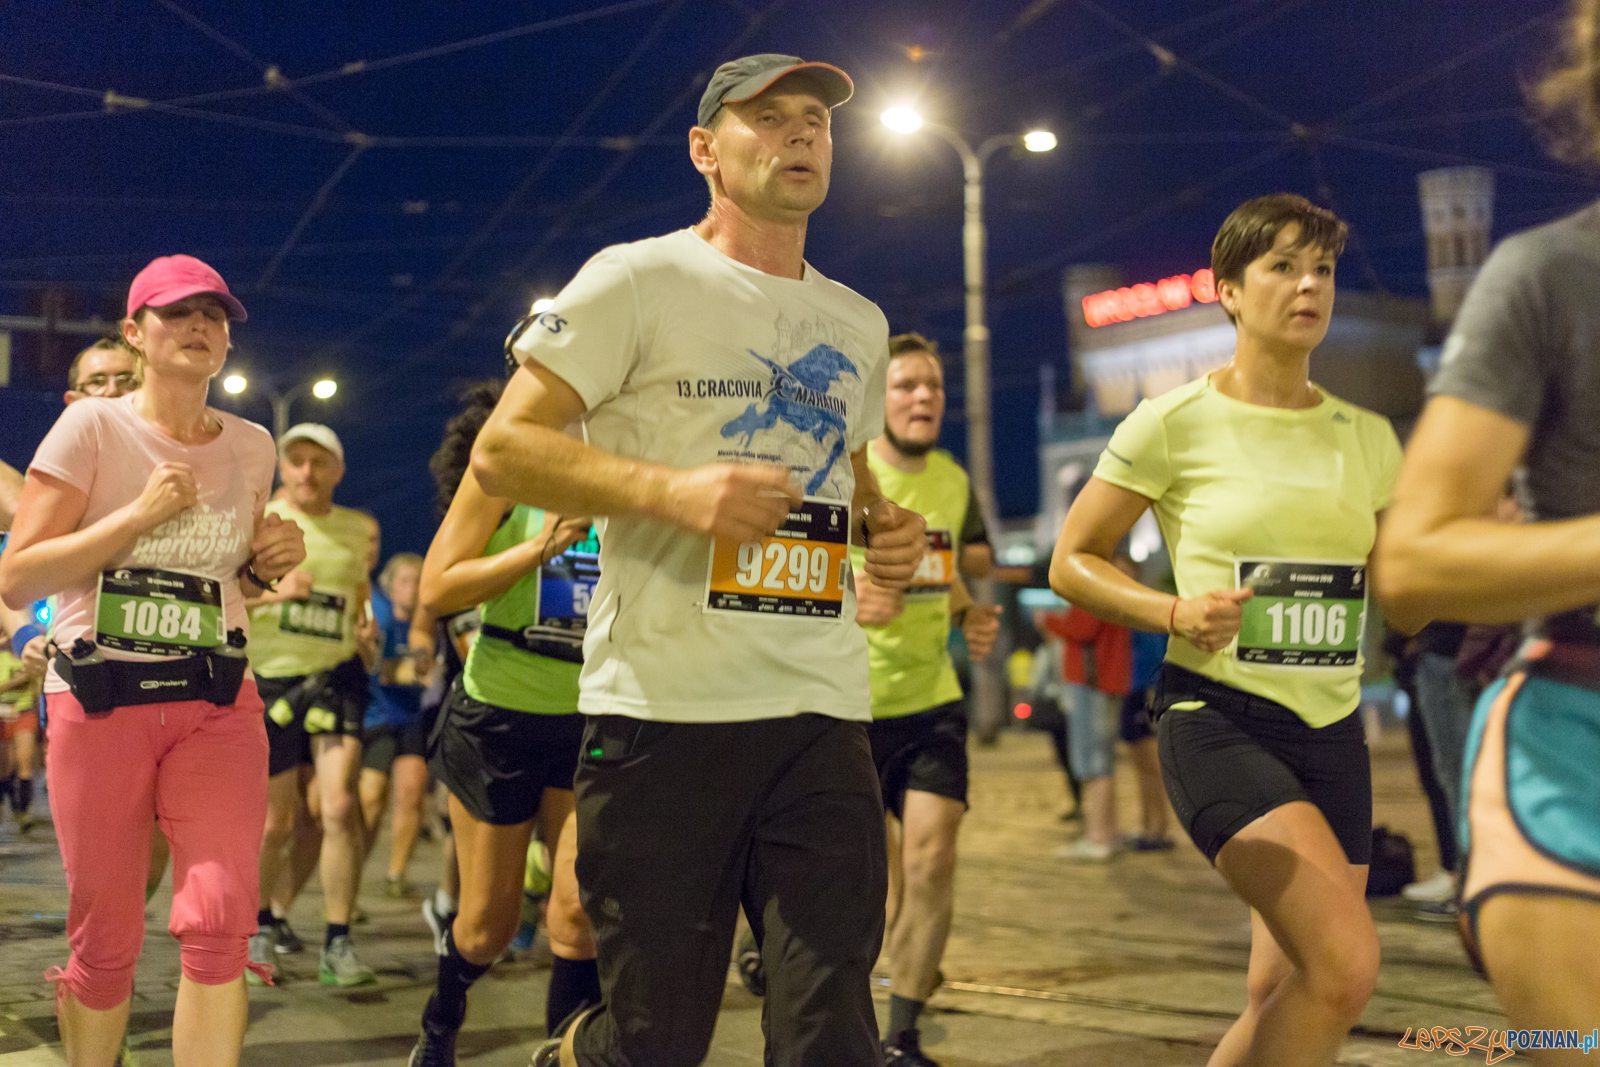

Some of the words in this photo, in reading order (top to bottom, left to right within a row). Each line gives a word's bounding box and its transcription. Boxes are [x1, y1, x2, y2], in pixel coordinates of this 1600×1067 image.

[795, 387, 847, 417] MARATON
[735, 541, 829, 594] 9299
[121, 600, 201, 641] 1084
[1266, 601, 1347, 646] 1106
